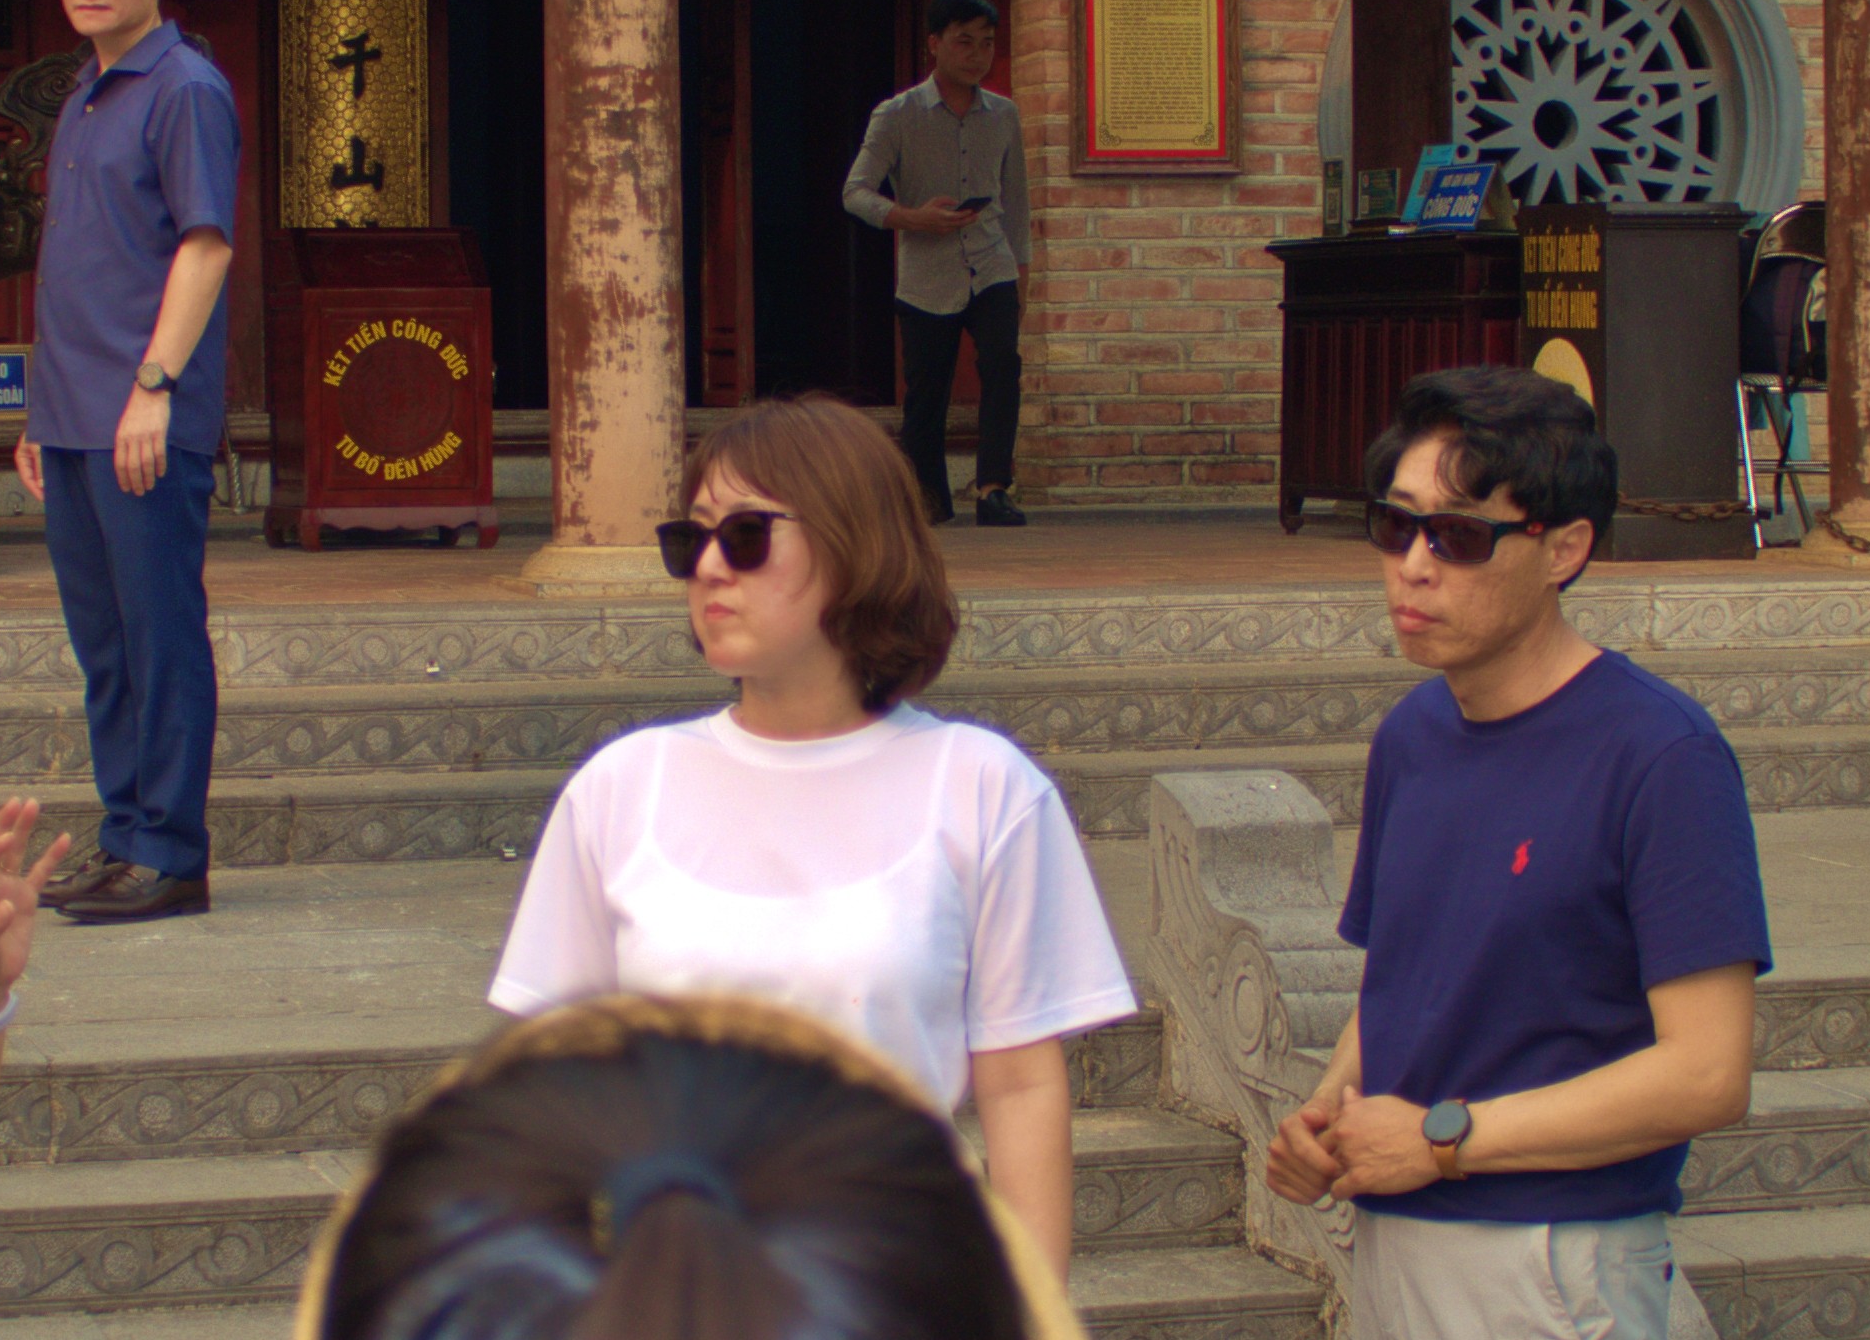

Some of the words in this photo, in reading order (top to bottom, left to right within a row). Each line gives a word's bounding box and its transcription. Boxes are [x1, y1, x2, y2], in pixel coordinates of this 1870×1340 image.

[1422, 193, 1455, 220] CÔNG
[1450, 189, 1479, 218] ĐỨC
[1558, 227, 1580, 272] CÔNG
[1581, 224, 1601, 272] ĐỨC
[345, 321, 387, 354] TIỀN
[392, 317, 443, 350] CÔNG
[439, 344, 469, 380] ĐỨC
[335, 434, 360, 459] TU
[384, 457, 419, 481] ĐỀN
[418, 431, 462, 472] HÙNG
